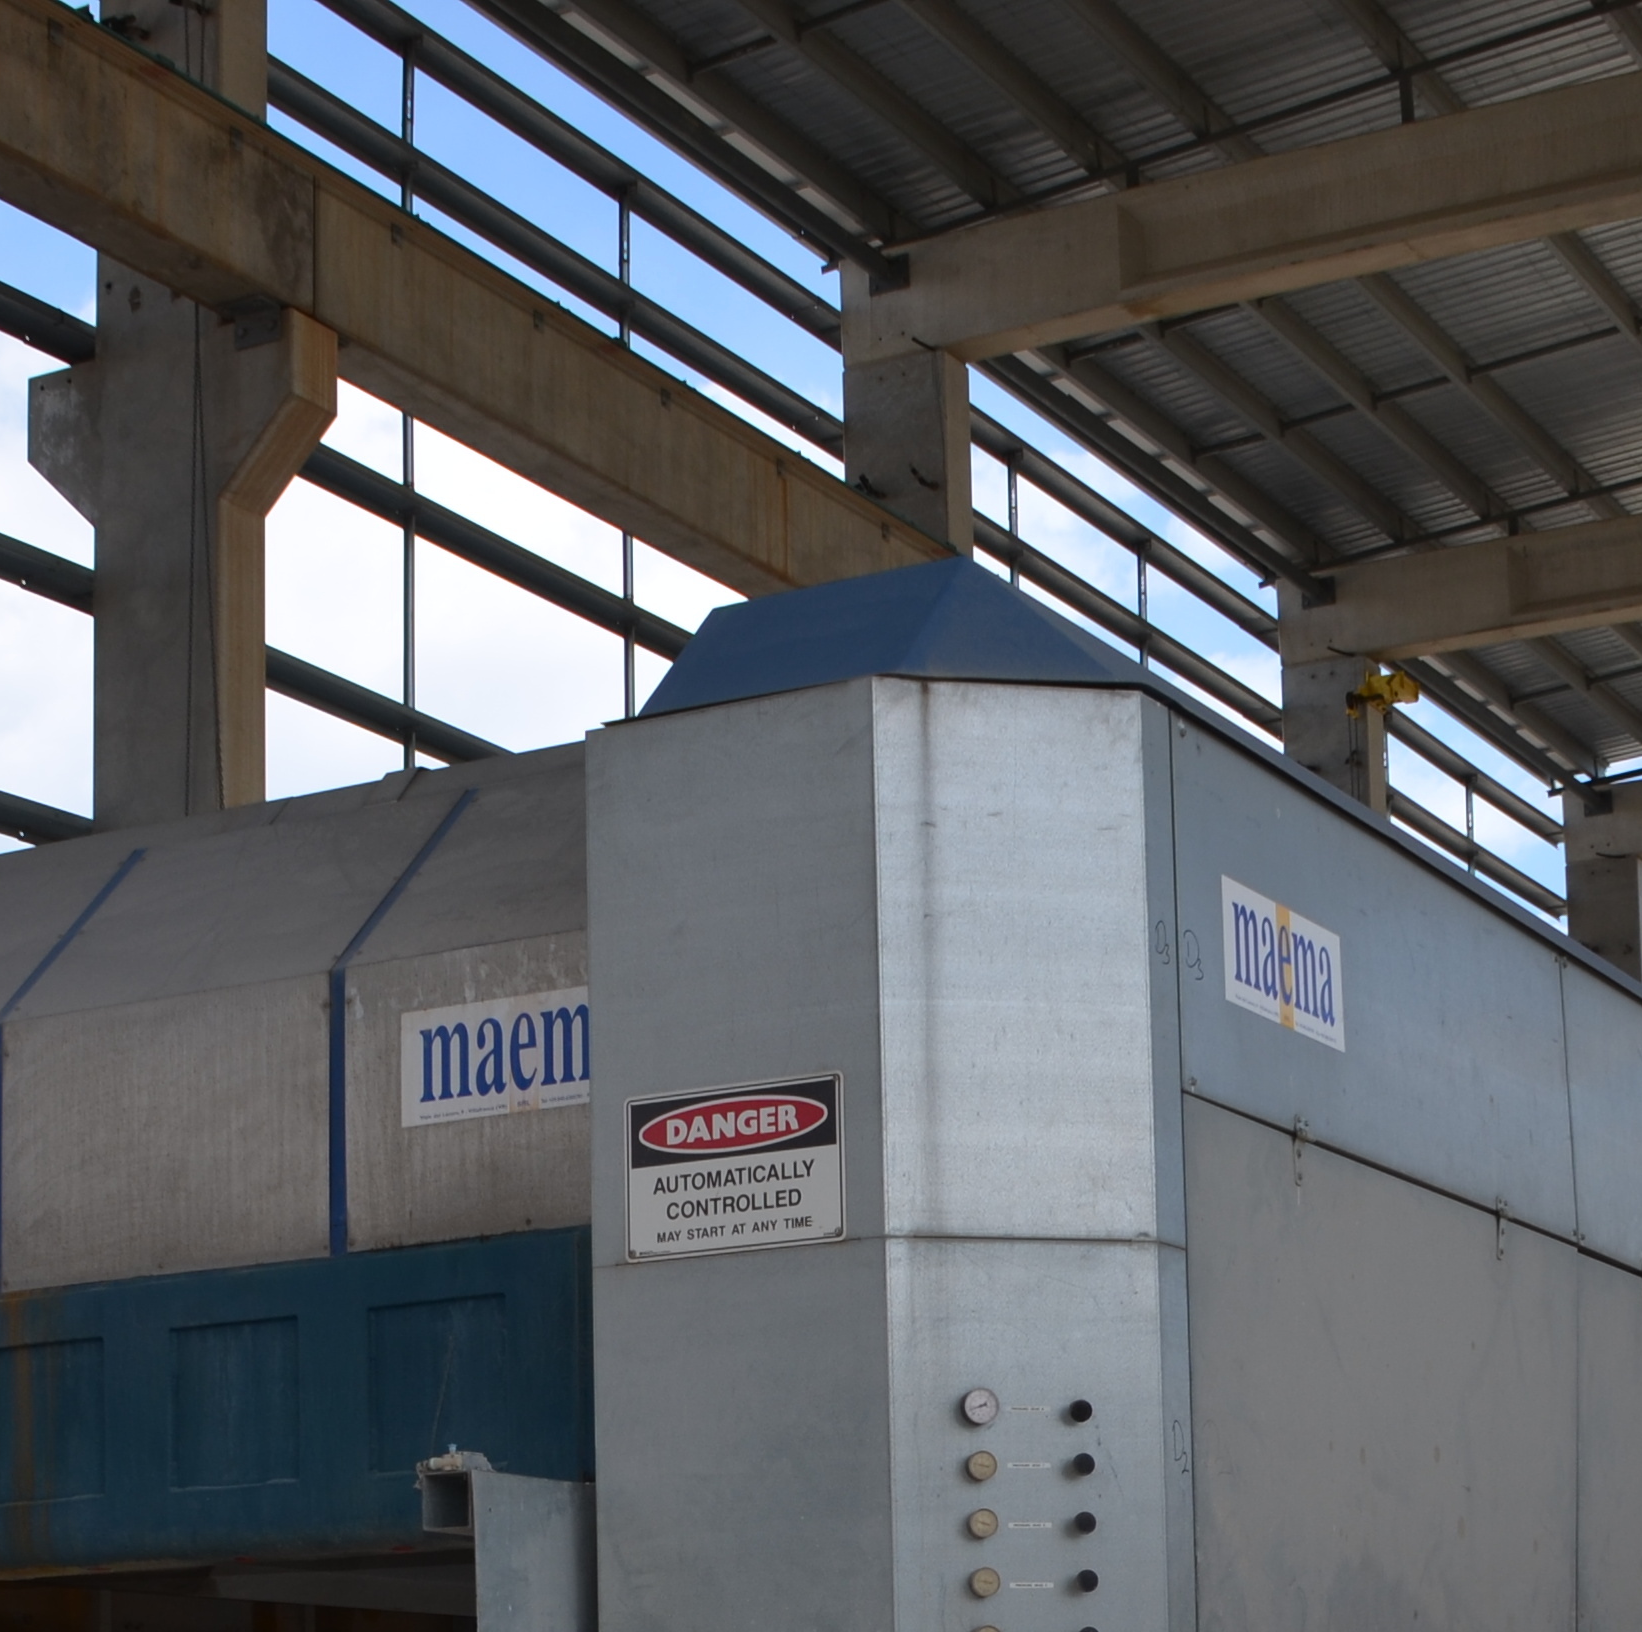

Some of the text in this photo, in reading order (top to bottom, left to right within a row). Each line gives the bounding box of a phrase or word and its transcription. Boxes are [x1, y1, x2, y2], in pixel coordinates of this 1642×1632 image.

[1232, 902, 1335, 1027] maema
[419, 1003, 590, 1103] maem
[666, 1104, 799, 1145] DANGER
[653, 1159, 815, 1195] AUTOMATICALLY
[666, 1188, 802, 1220] CONTROLLED
[657, 1216, 813, 1243] MAY START AT ANY TIME
